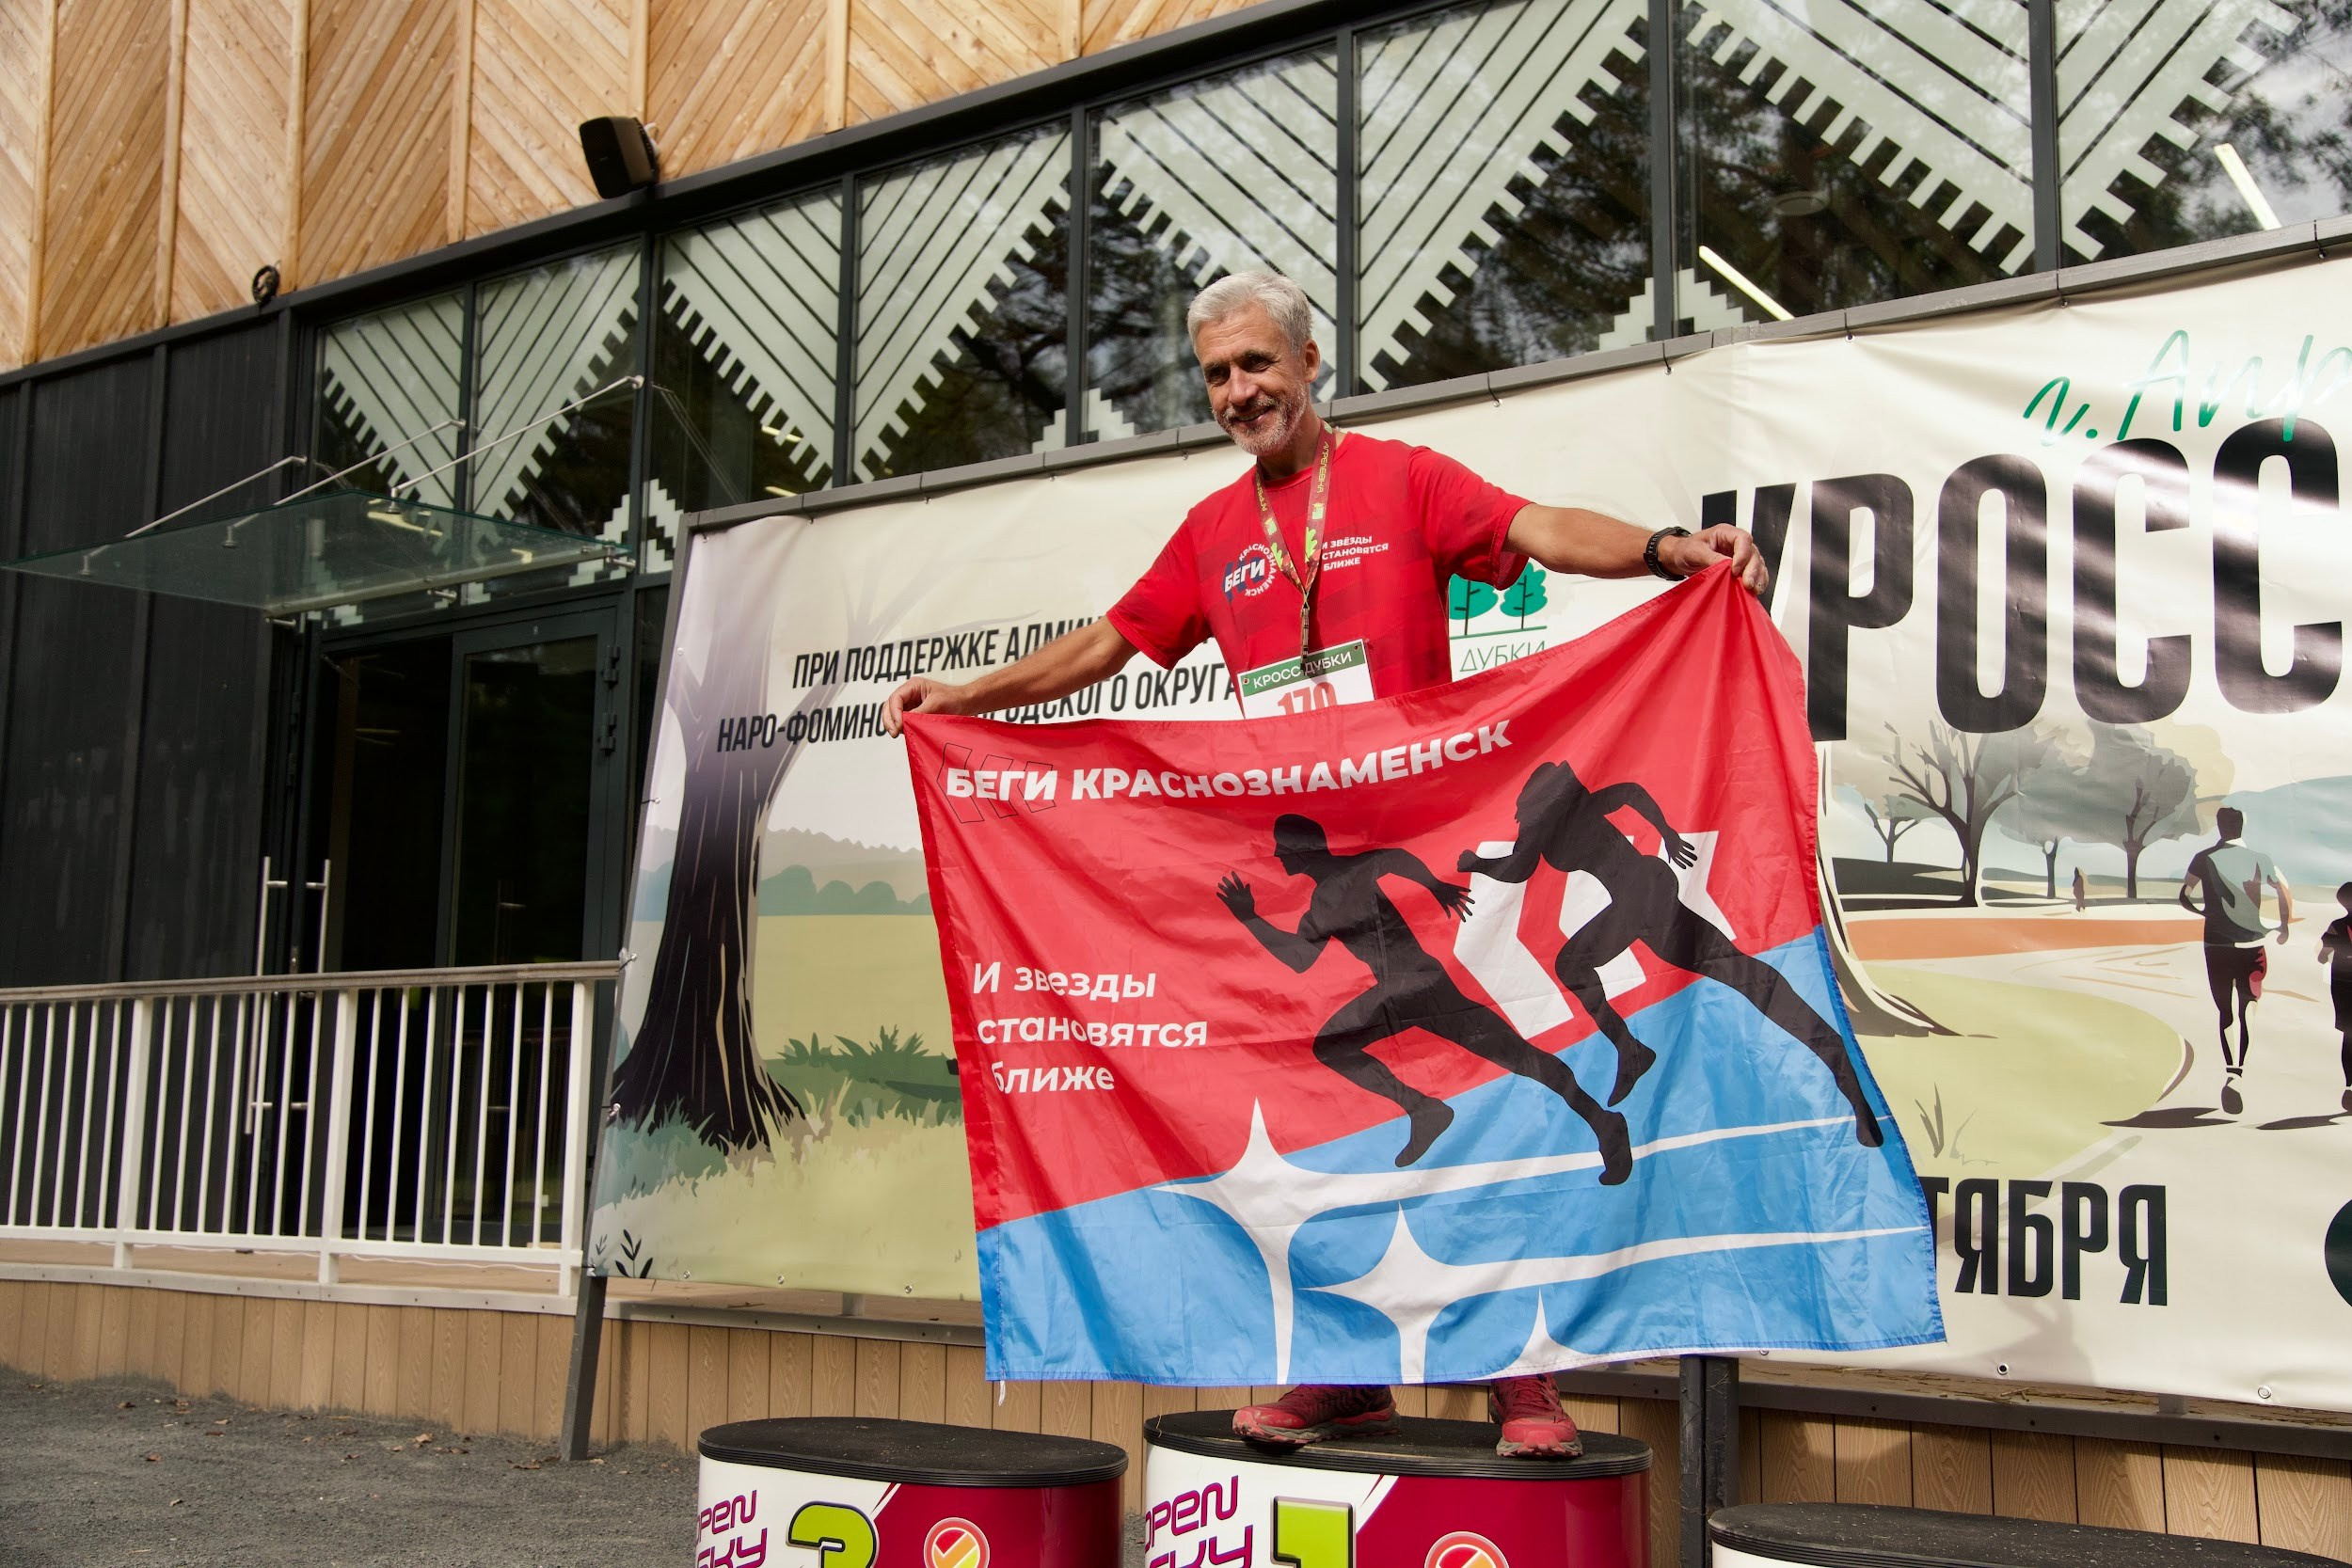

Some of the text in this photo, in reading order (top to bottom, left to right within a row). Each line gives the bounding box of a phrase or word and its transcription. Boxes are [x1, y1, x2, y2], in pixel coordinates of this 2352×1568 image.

[1322, 543, 1389, 561] СТАНОВЯТСЯ
[1330, 535, 1373, 548] ЗВЁЗДЫ
[1224, 559, 1265, 594] БЕГИ
[1323, 557, 1361, 572] БЛИЖЕ
[792, 650, 840, 689] ПРИ
[844, 628, 999, 684] ПОДДЕРЖКЕ
[1253, 651, 1352, 689] КРОСС ДУБКИ
[946, 720, 1513, 800] БЕГИ КРАСНОЗНАМЕНСК
[973, 961, 1156, 1003] И звезды
[977, 1016, 1208, 1048] становятся
[992, 1061, 1115, 1095] ближе
